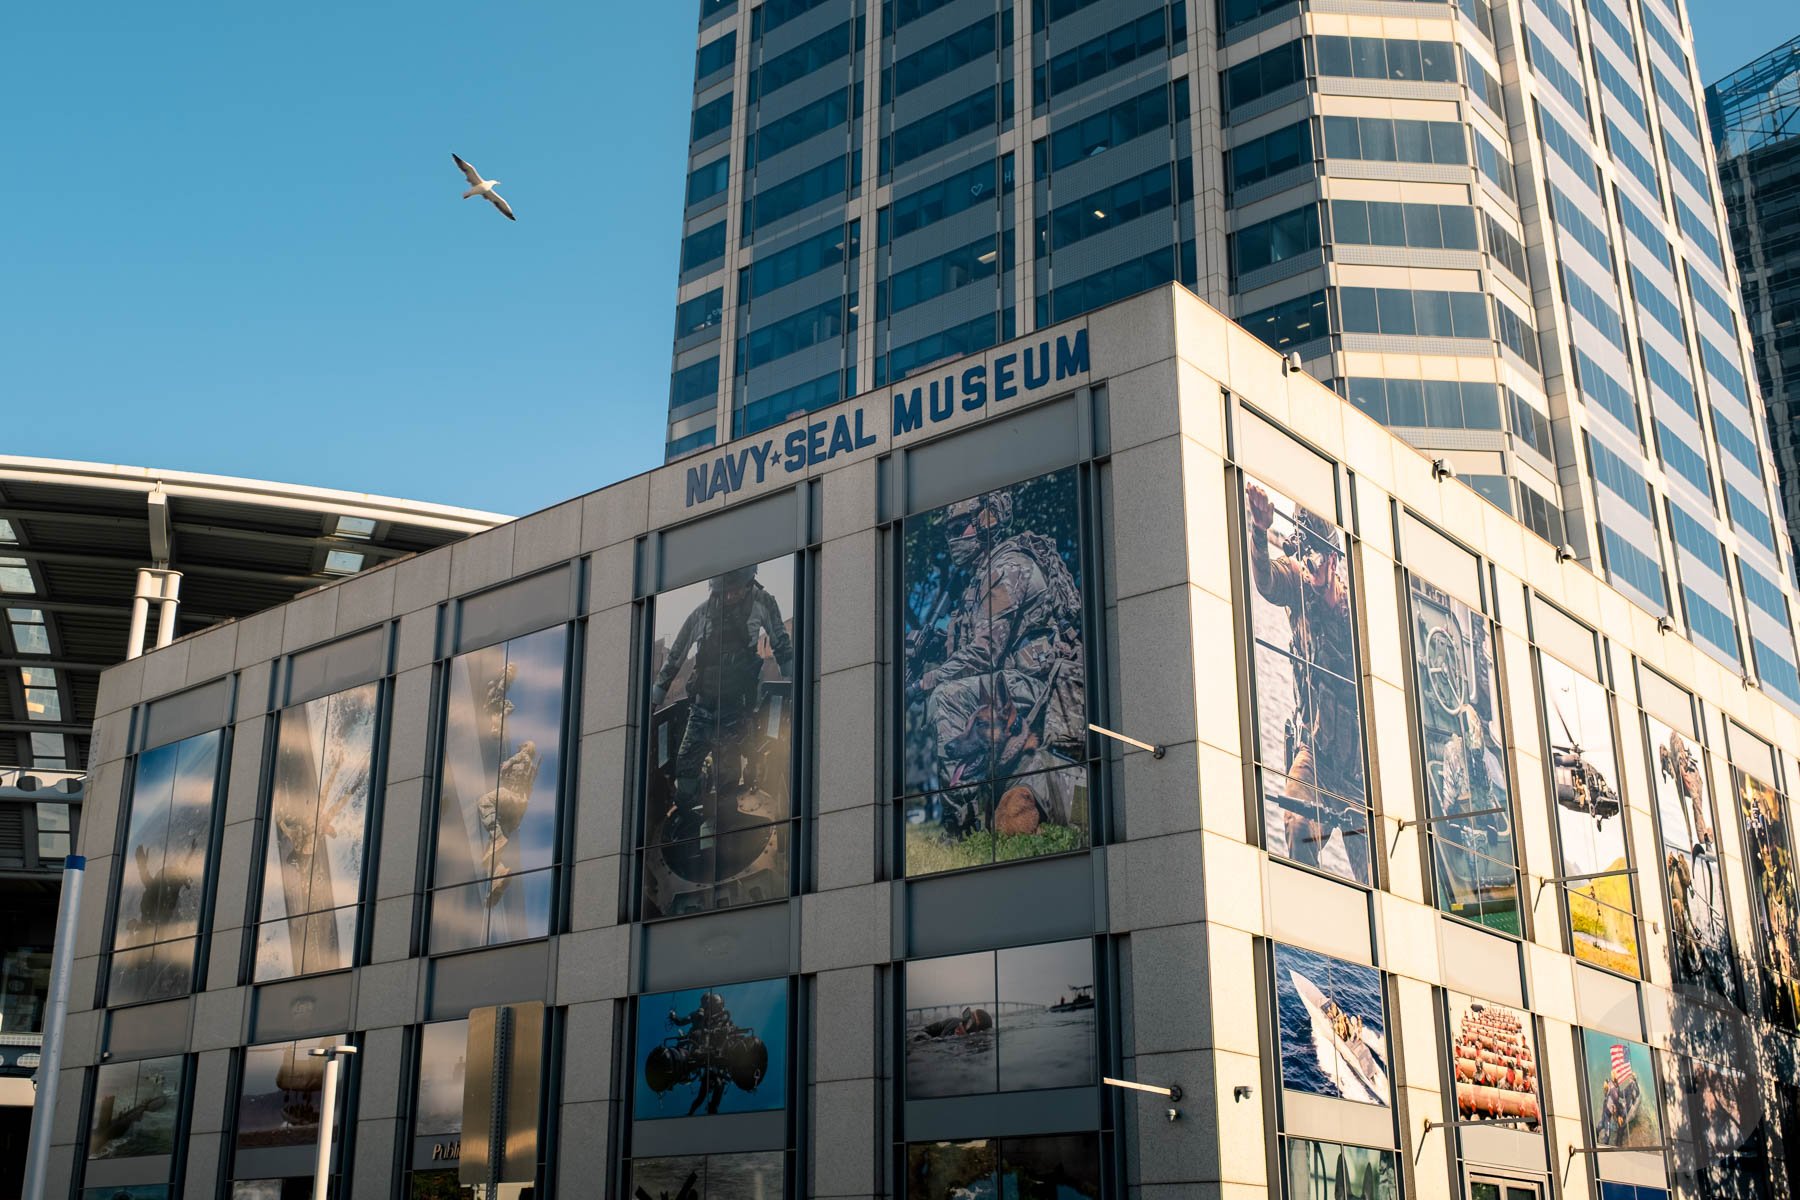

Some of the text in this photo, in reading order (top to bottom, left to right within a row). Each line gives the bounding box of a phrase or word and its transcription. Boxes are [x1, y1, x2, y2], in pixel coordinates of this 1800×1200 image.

[686, 328, 1090, 507] NAVY SEAL MUSEUM
[432, 1141, 461, 1160] Publi
